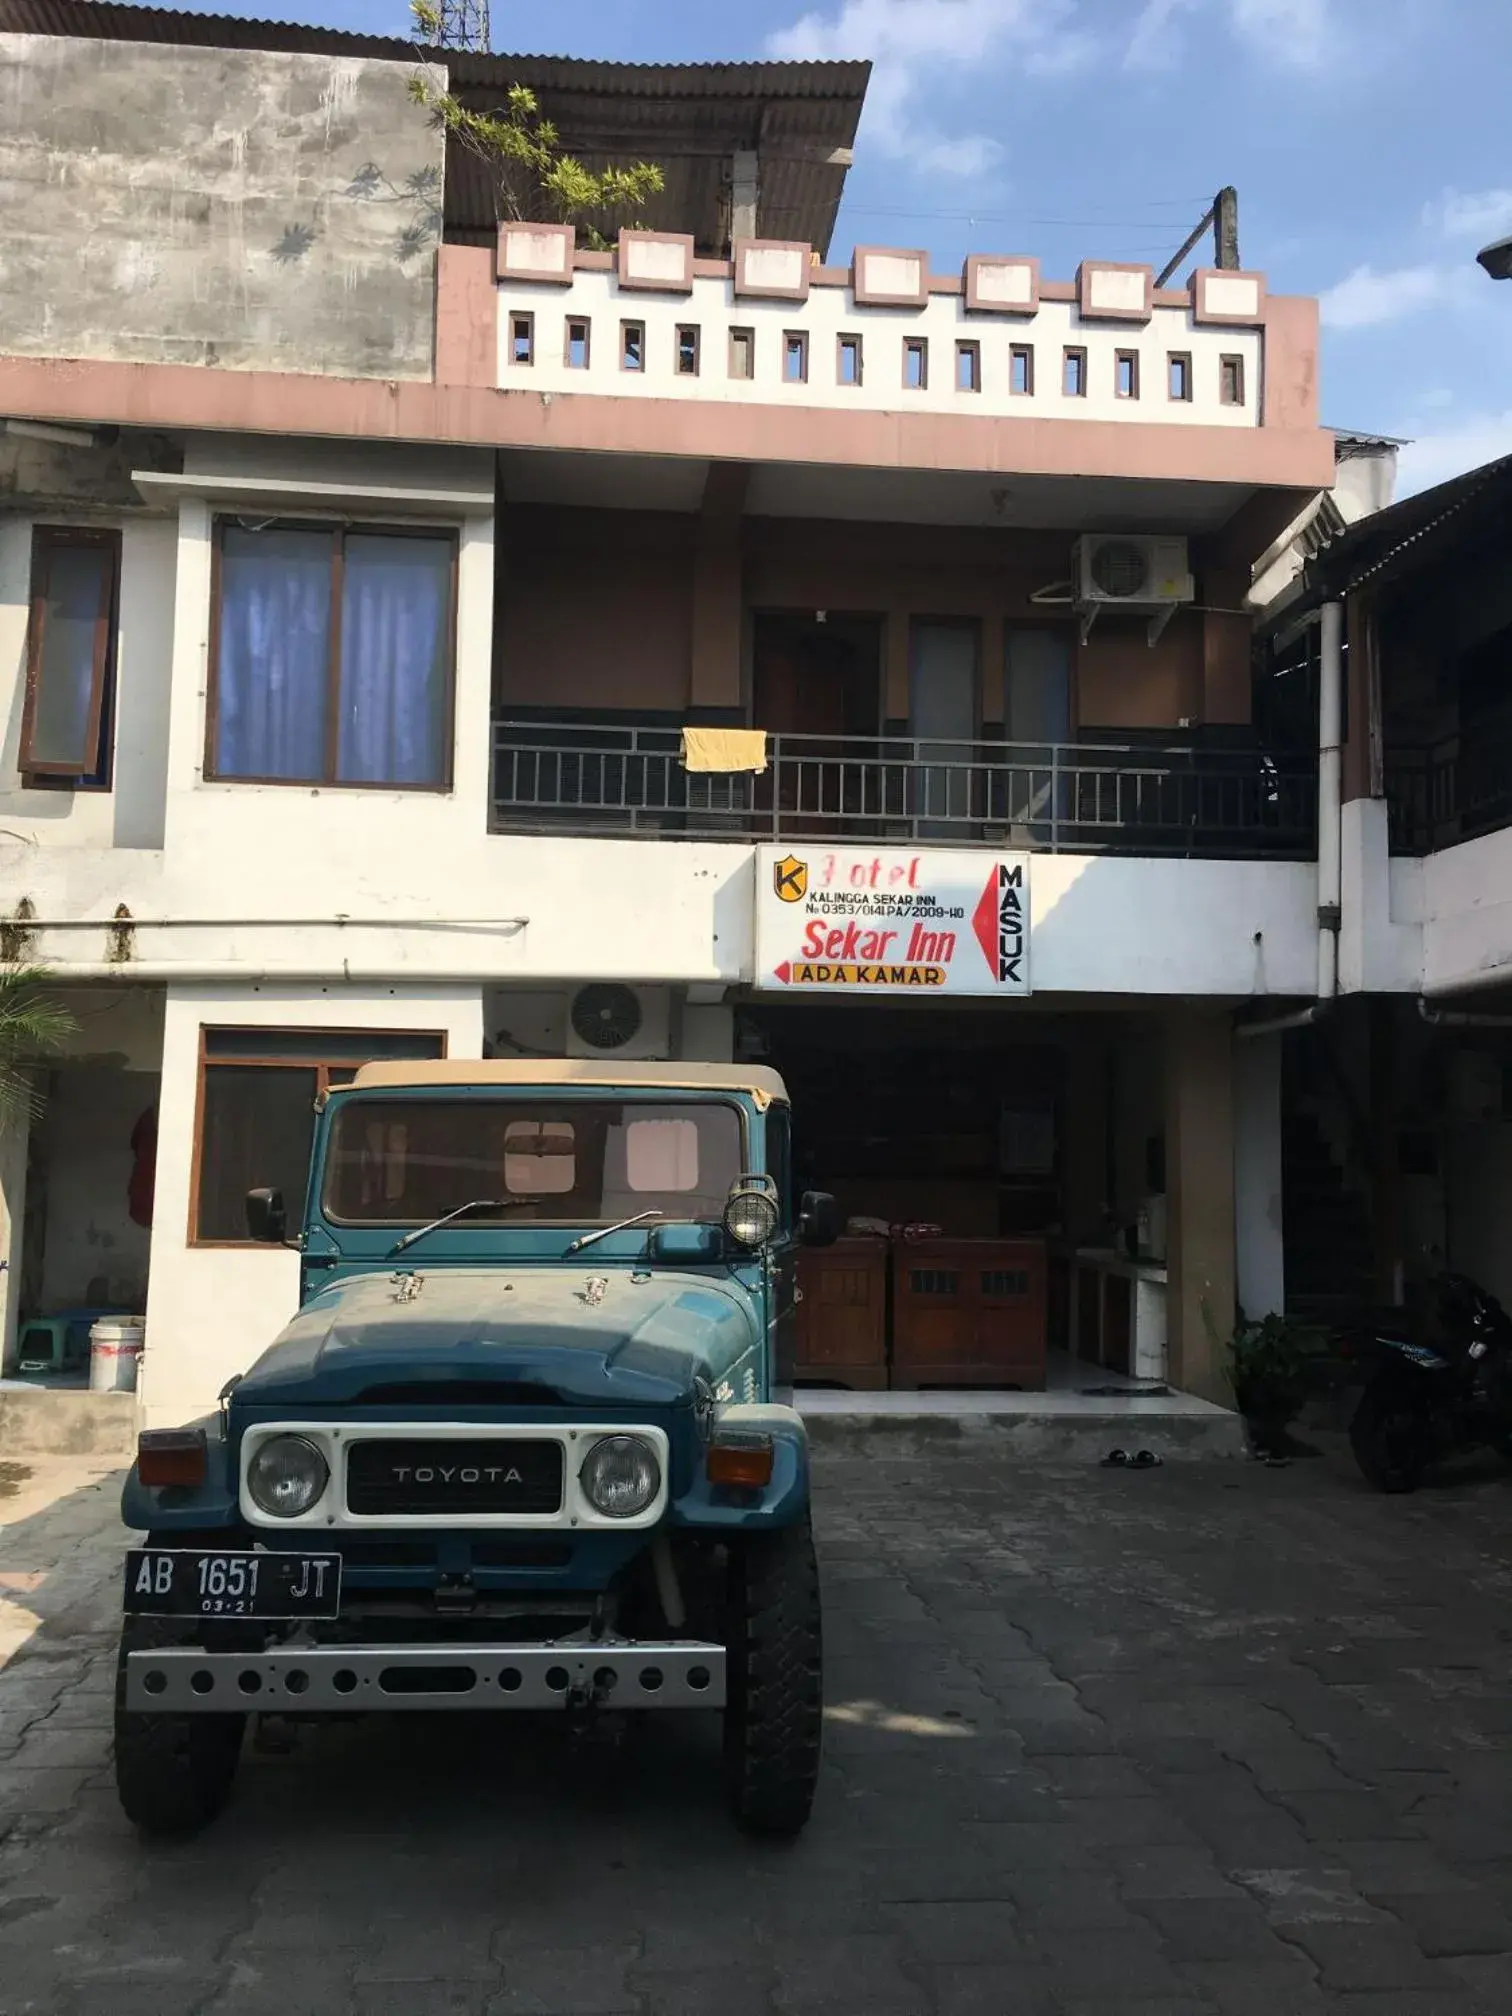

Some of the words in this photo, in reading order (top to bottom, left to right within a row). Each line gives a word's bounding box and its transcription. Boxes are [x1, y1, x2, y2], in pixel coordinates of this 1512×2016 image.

[776, 865, 804, 895] K
[809, 892, 869, 905] KALINGGA
[873, 893, 913, 906] SEKAR
[916, 895, 936, 907] INN
[999, 864, 1023, 982] MASUK
[801, 919, 898, 960] Sekar
[905, 922, 956, 963] Inn
[800, 964, 848, 982] ADA
[857, 966, 940, 985] KAMAR
[392, 1466, 522, 1483] TOYOTA
[135, 1556, 174, 1594] AB
[198, 1557, 259, 1597] 1651
[290, 1560, 331, 1598] JT
